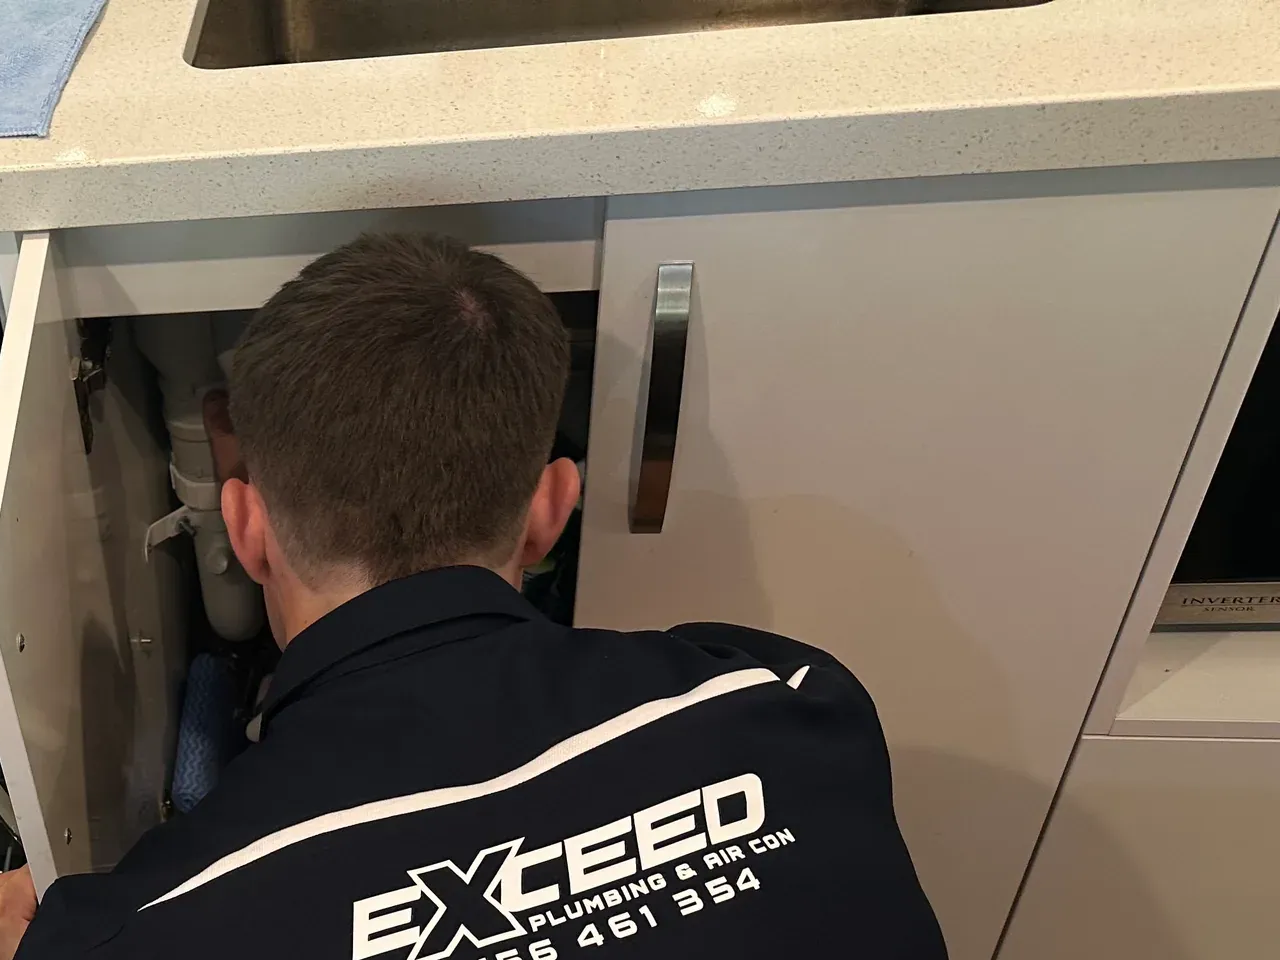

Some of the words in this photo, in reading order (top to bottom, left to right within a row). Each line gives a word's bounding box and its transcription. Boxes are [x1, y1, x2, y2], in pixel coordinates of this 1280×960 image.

[1182, 596, 1280, 605] INVERTER
[528, 872, 667, 933] PLUMBING
[675, 862, 698, 881] &
[702, 845, 746, 870] AIR
[748, 827, 796, 855] CON
[576, 904, 658, 948] 461
[671, 866, 761, 917] 354
